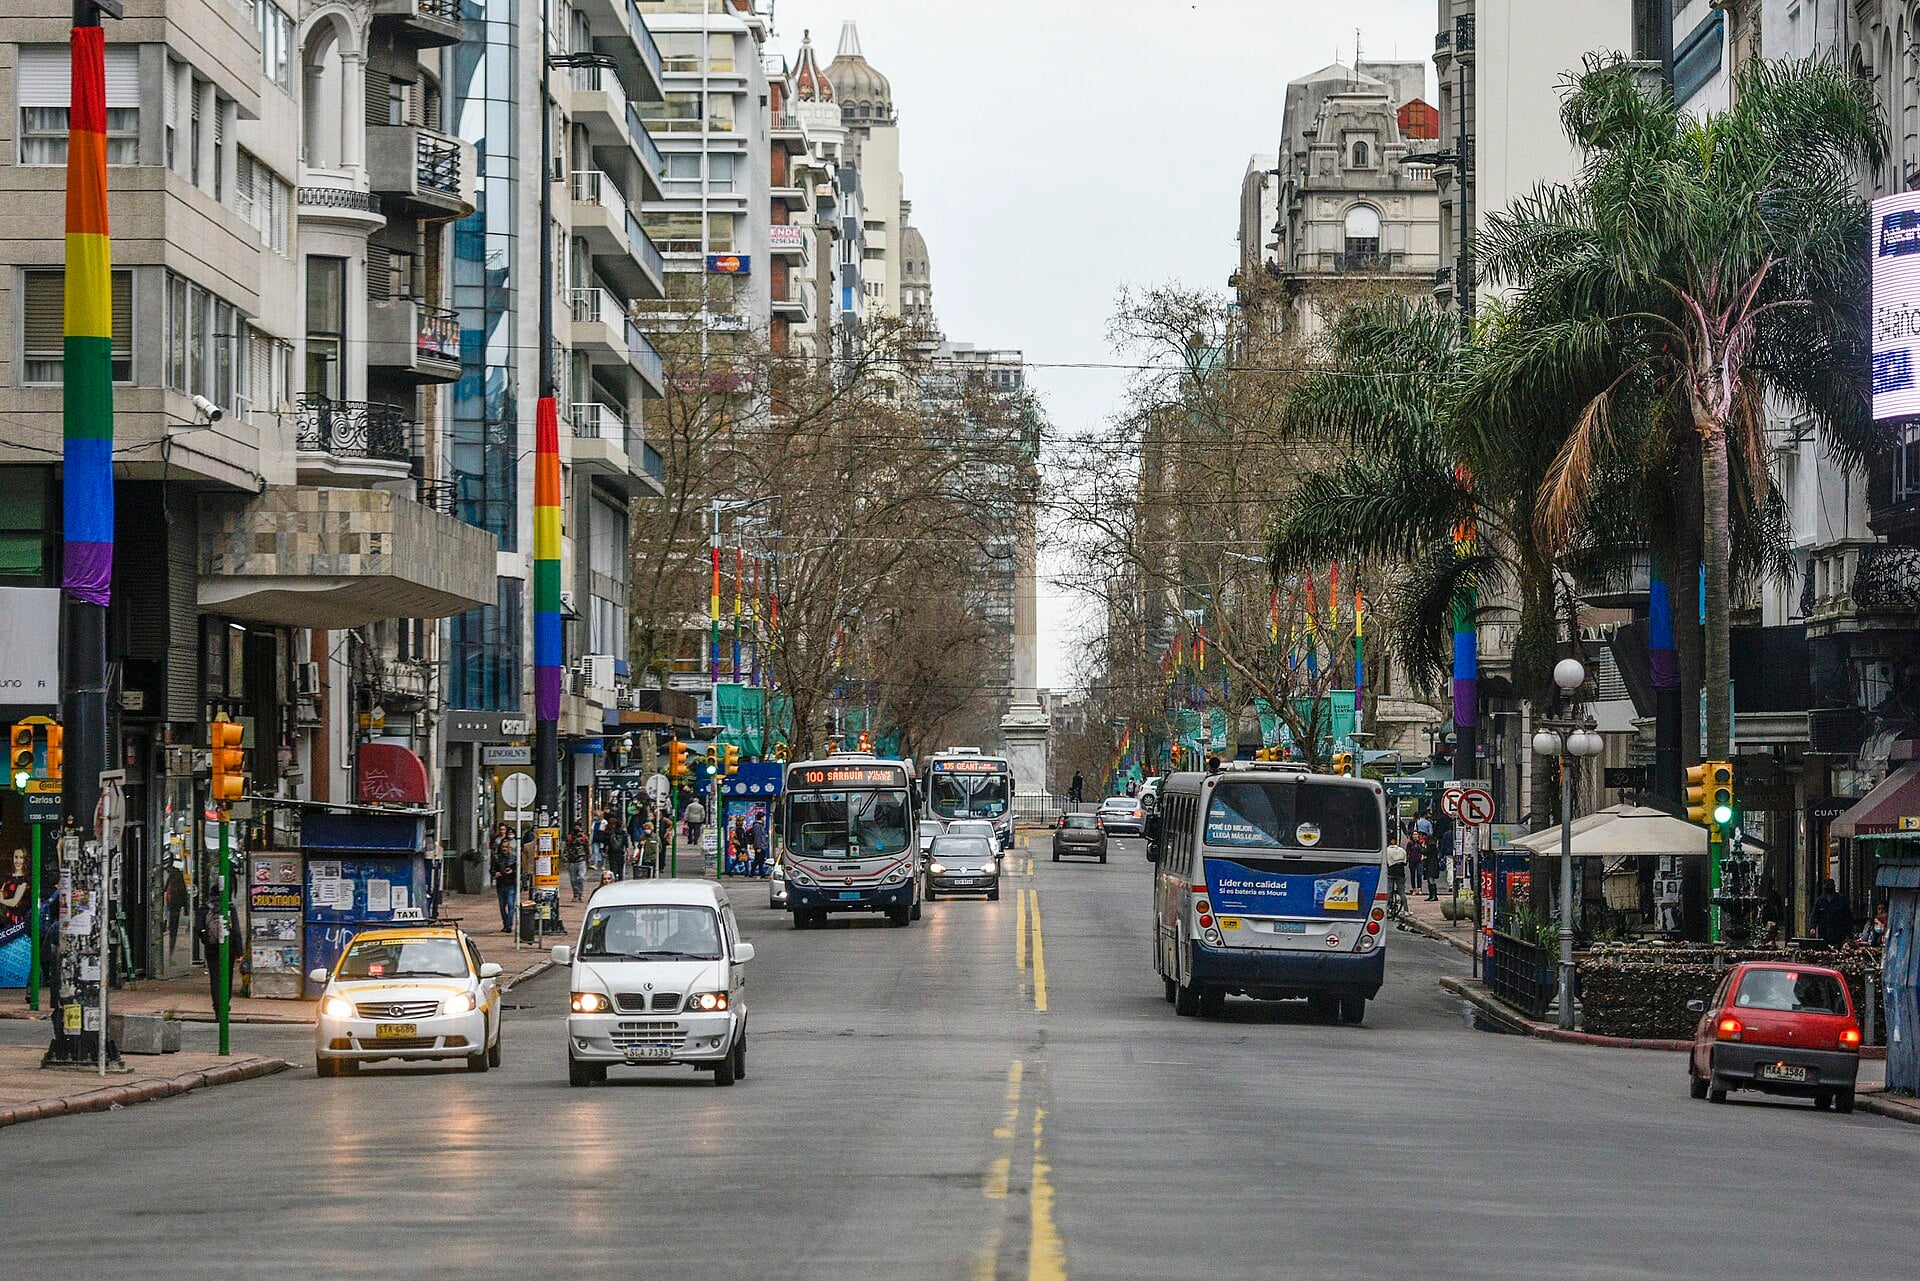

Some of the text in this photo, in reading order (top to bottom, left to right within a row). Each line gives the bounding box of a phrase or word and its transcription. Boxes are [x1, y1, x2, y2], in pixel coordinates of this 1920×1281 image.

[805, 771, 824, 782] 100
[29, 795, 53, 804] Carlos
[1219, 879, 1241, 888] Líder
[1255, 880, 1287, 889] calidad
[251, 893, 301, 907] CRUCIMANÍA
[396, 911, 419, 919] TAXI
